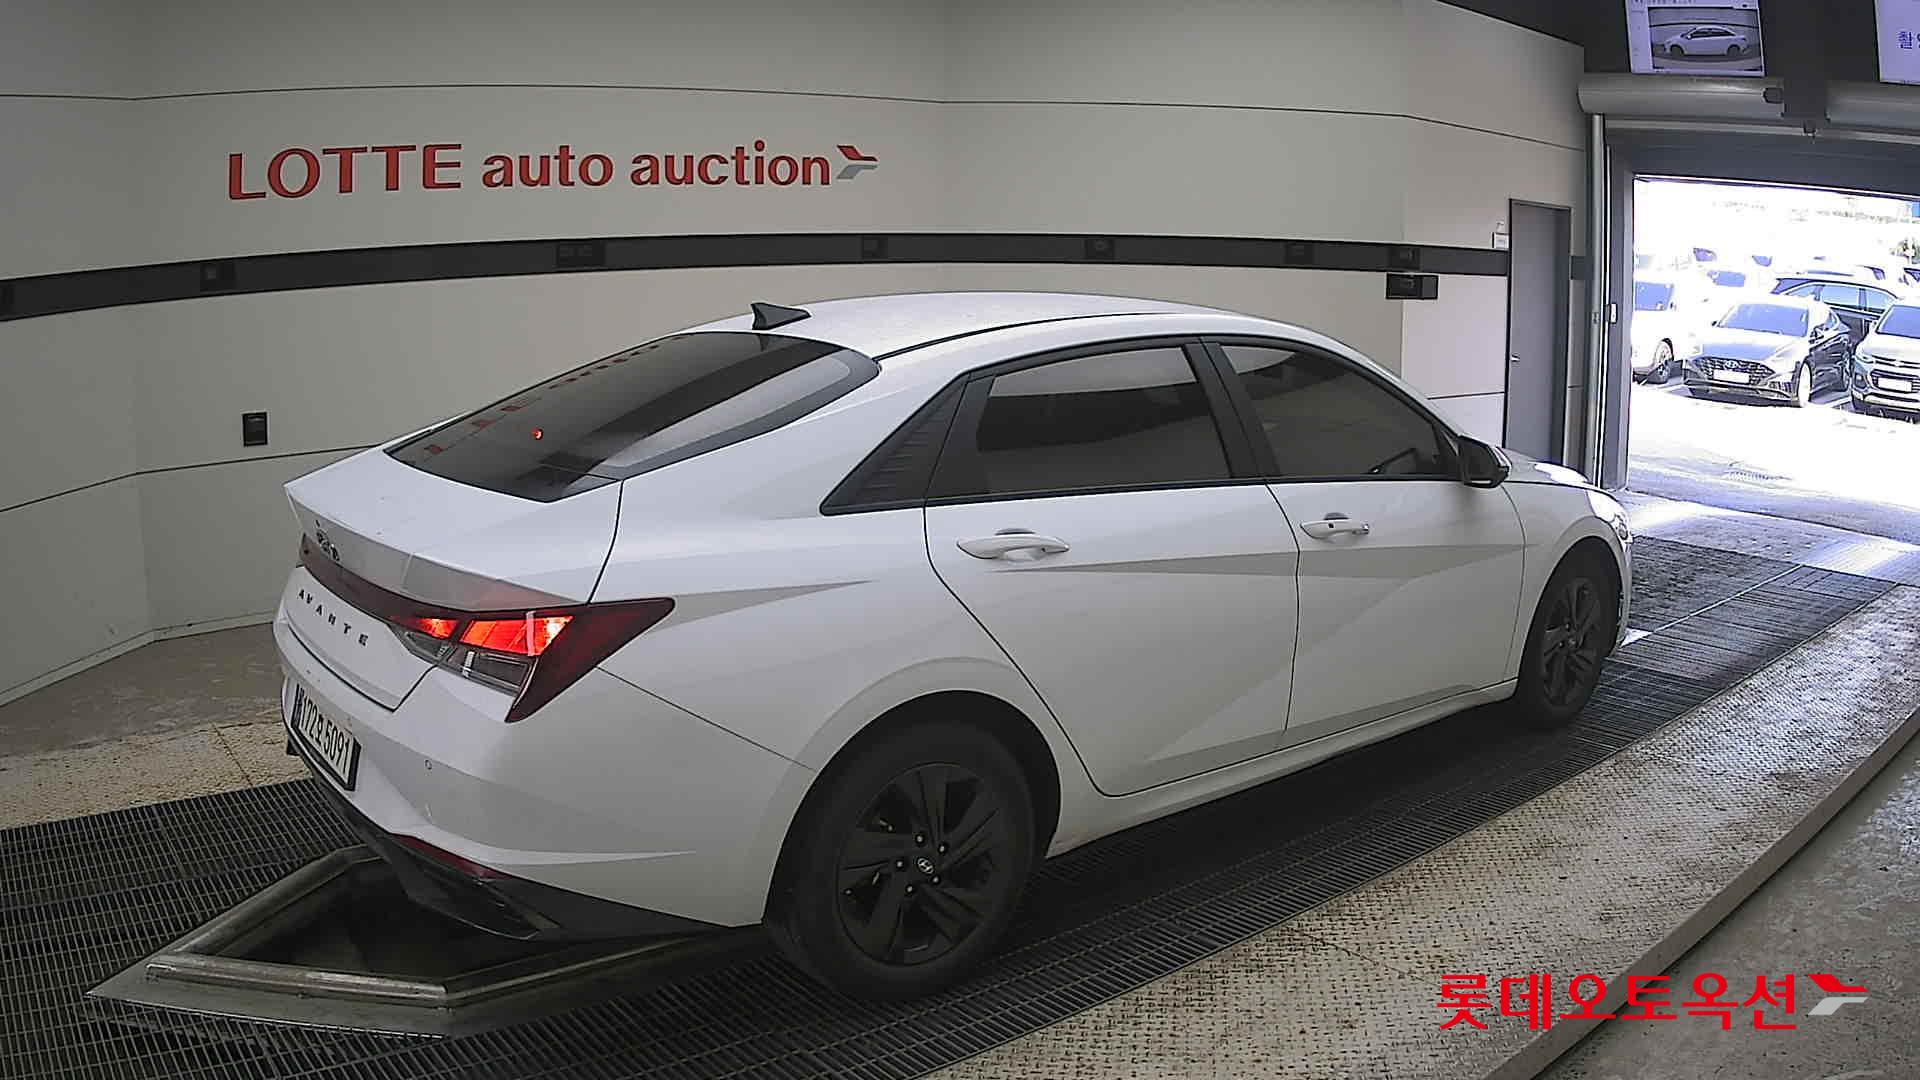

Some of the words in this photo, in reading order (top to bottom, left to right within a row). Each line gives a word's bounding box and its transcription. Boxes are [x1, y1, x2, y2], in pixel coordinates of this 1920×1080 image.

[229, 143, 462, 200] LOTTE
[482, 145, 613, 188] auto
[630, 139, 830, 186] auction
[298, 589, 368, 647] AVANTE
[301, 694, 323, 746] 172호
[324, 719, 350, 775] 5091
